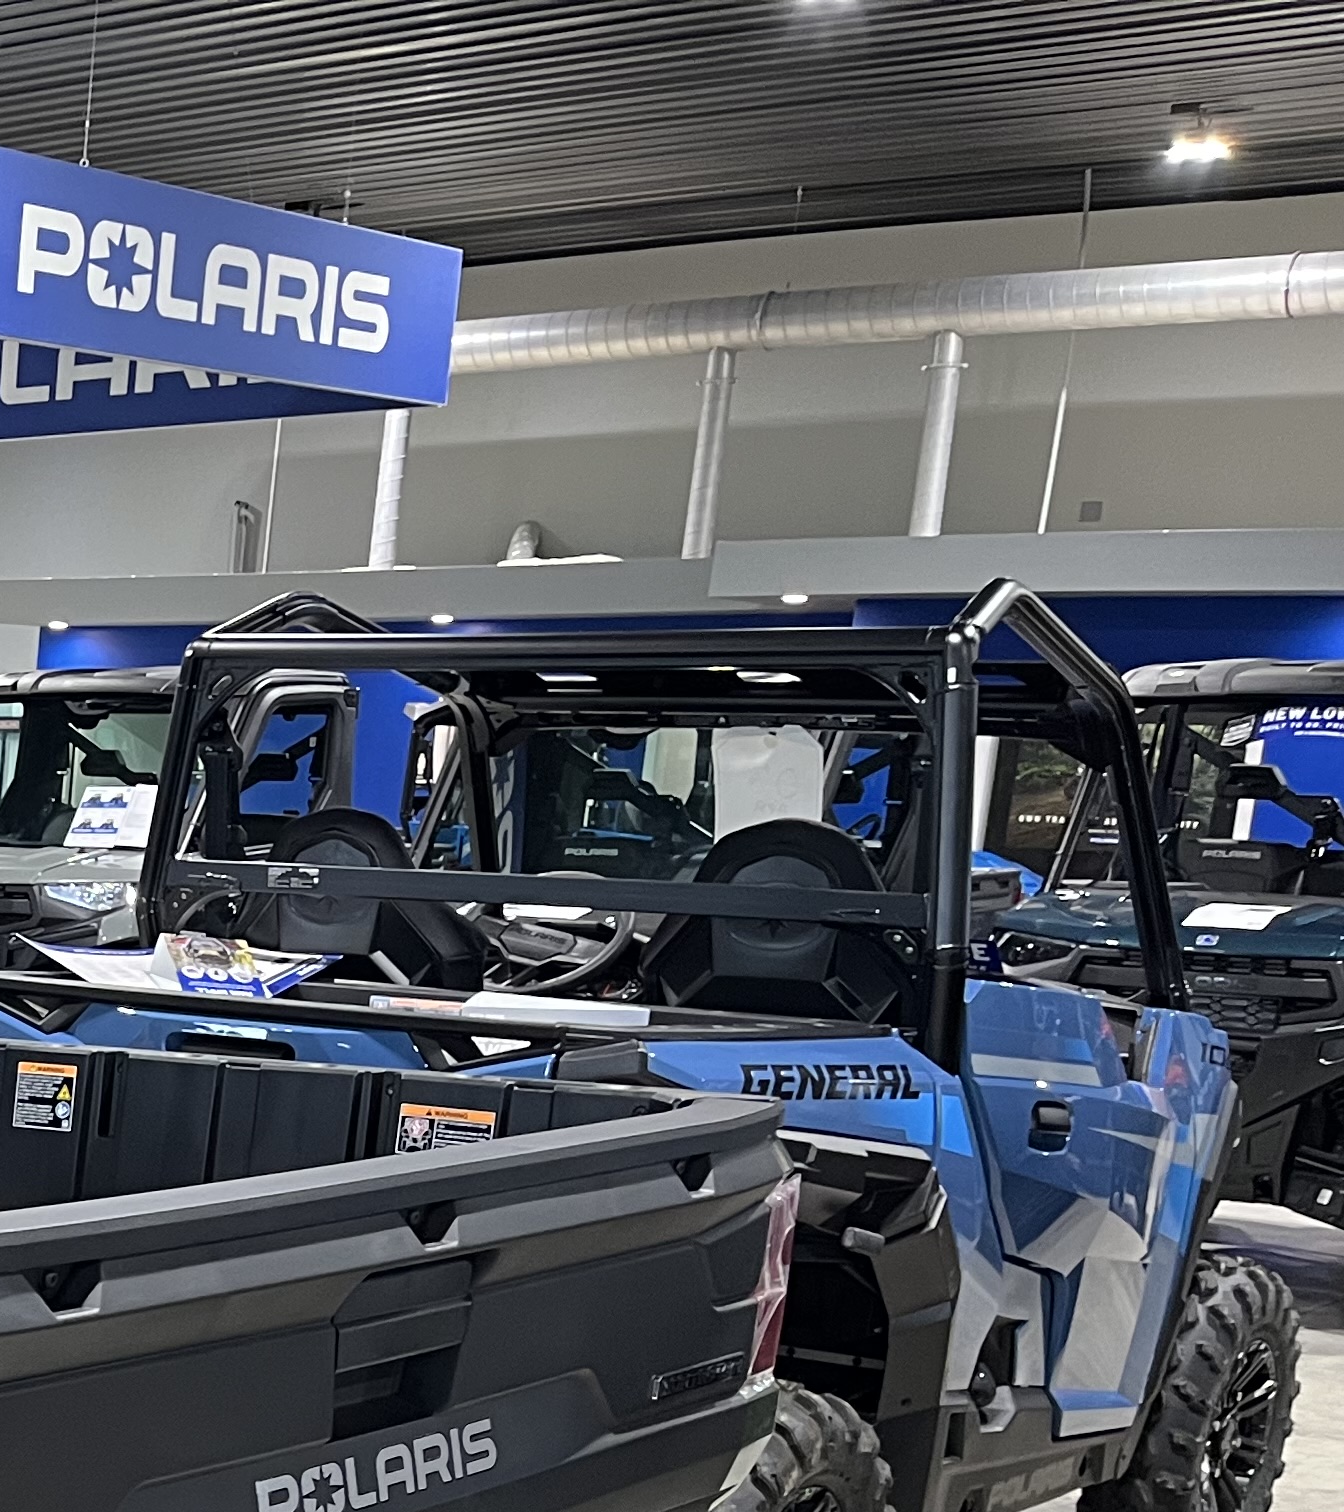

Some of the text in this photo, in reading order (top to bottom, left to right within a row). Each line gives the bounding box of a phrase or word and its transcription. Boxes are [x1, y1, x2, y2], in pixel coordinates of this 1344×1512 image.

[17, 203, 390, 353] POLARIS
[1262, 707, 1307, 723] NEW
[740, 1064, 921, 1100] GENERAL
